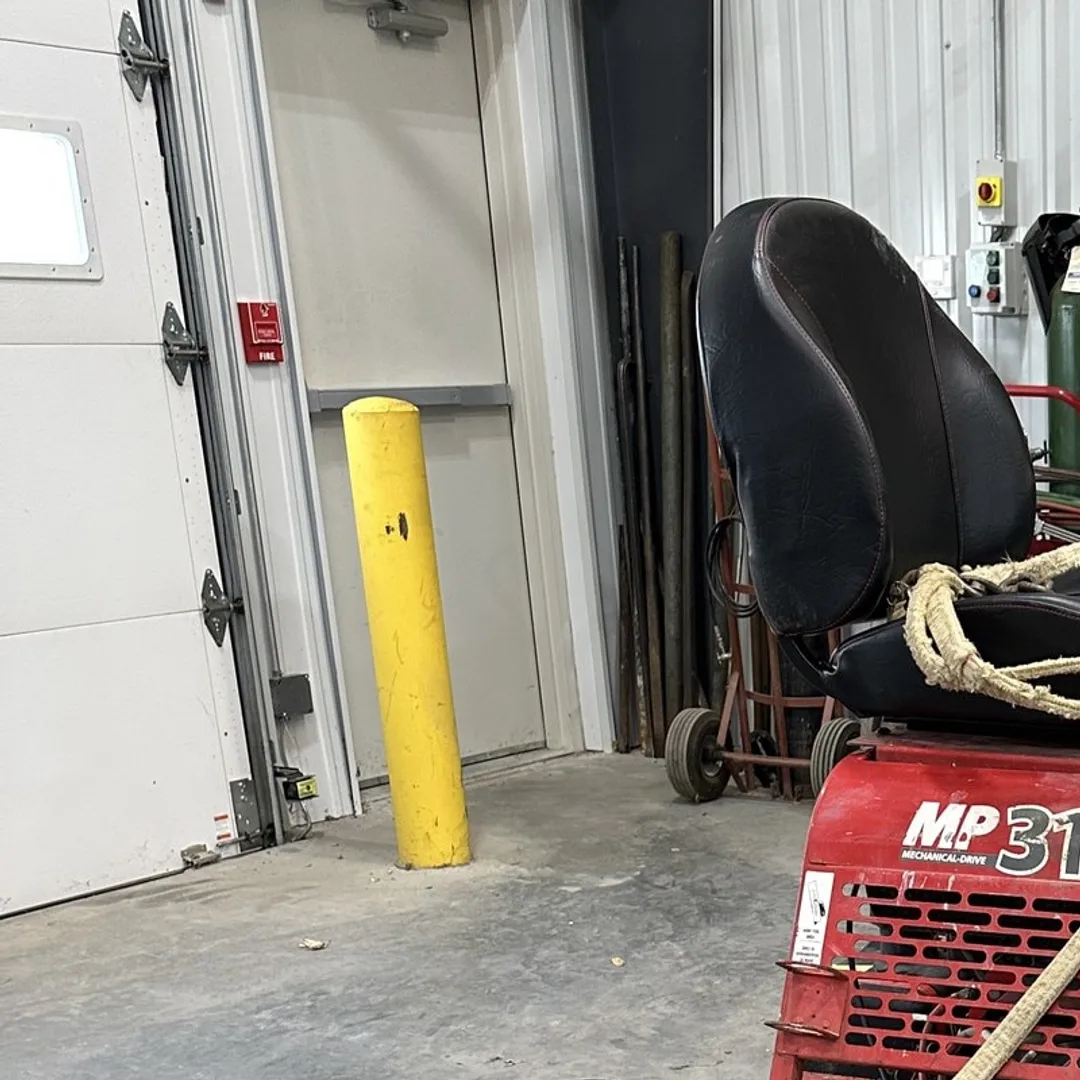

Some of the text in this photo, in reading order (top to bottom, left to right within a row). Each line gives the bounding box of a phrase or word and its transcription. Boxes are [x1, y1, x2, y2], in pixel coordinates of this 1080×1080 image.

[259, 351, 276, 361] FIRE
[901, 800, 1000, 850] MP
[902, 849, 988, 867] MECHANICAL-DRIVE
